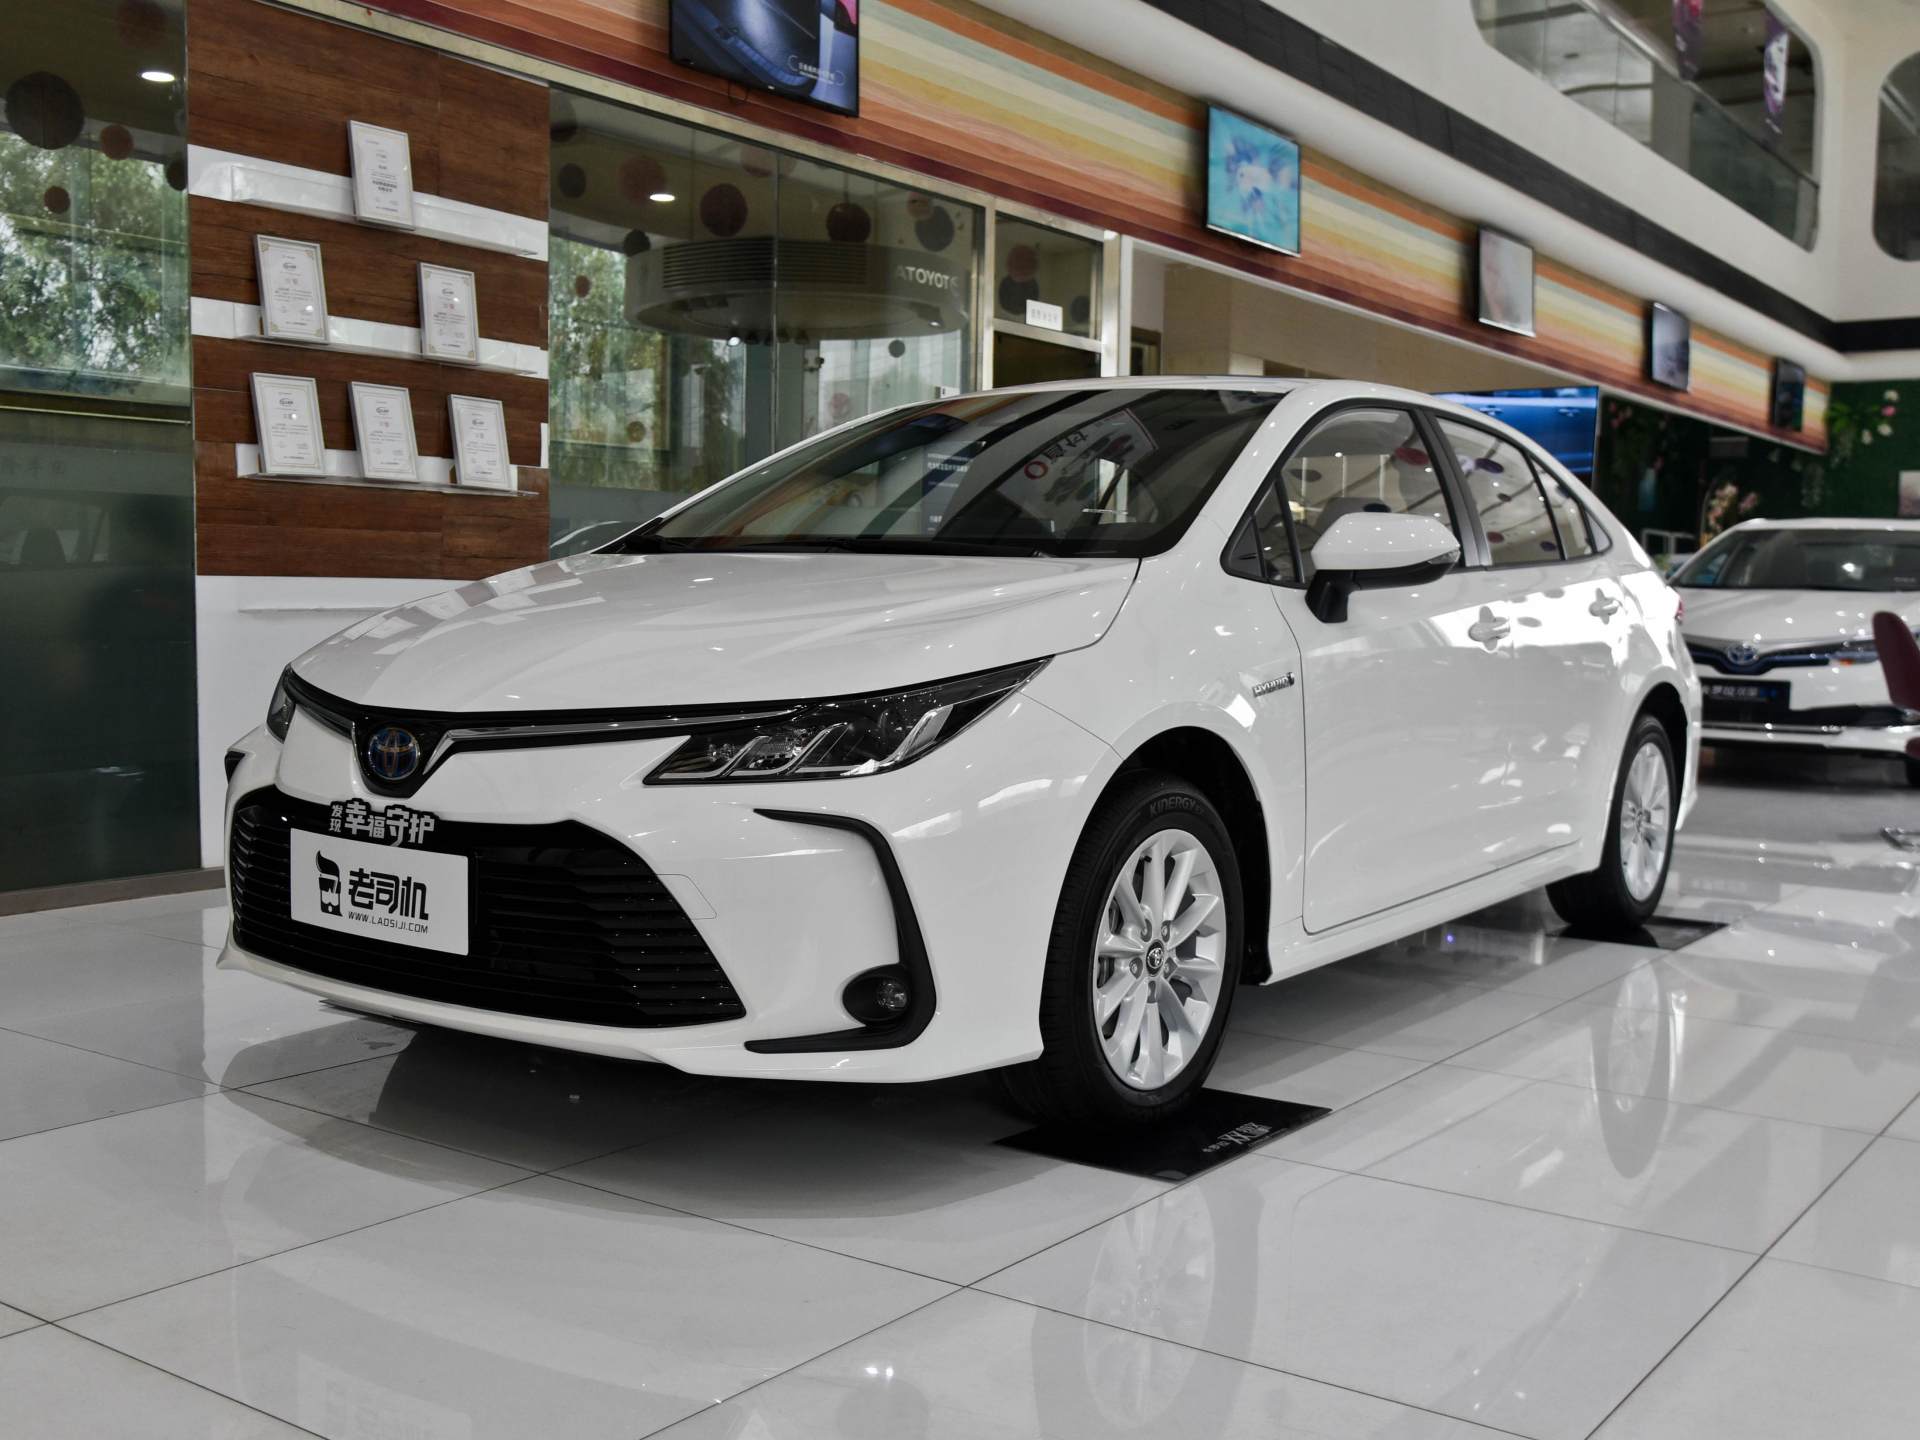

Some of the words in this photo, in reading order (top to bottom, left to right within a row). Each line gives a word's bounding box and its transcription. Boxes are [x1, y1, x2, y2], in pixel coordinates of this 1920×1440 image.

[348, 868, 429, 921] 老司机
[348, 910, 429, 935] WWW.LAOSIJI.COM
